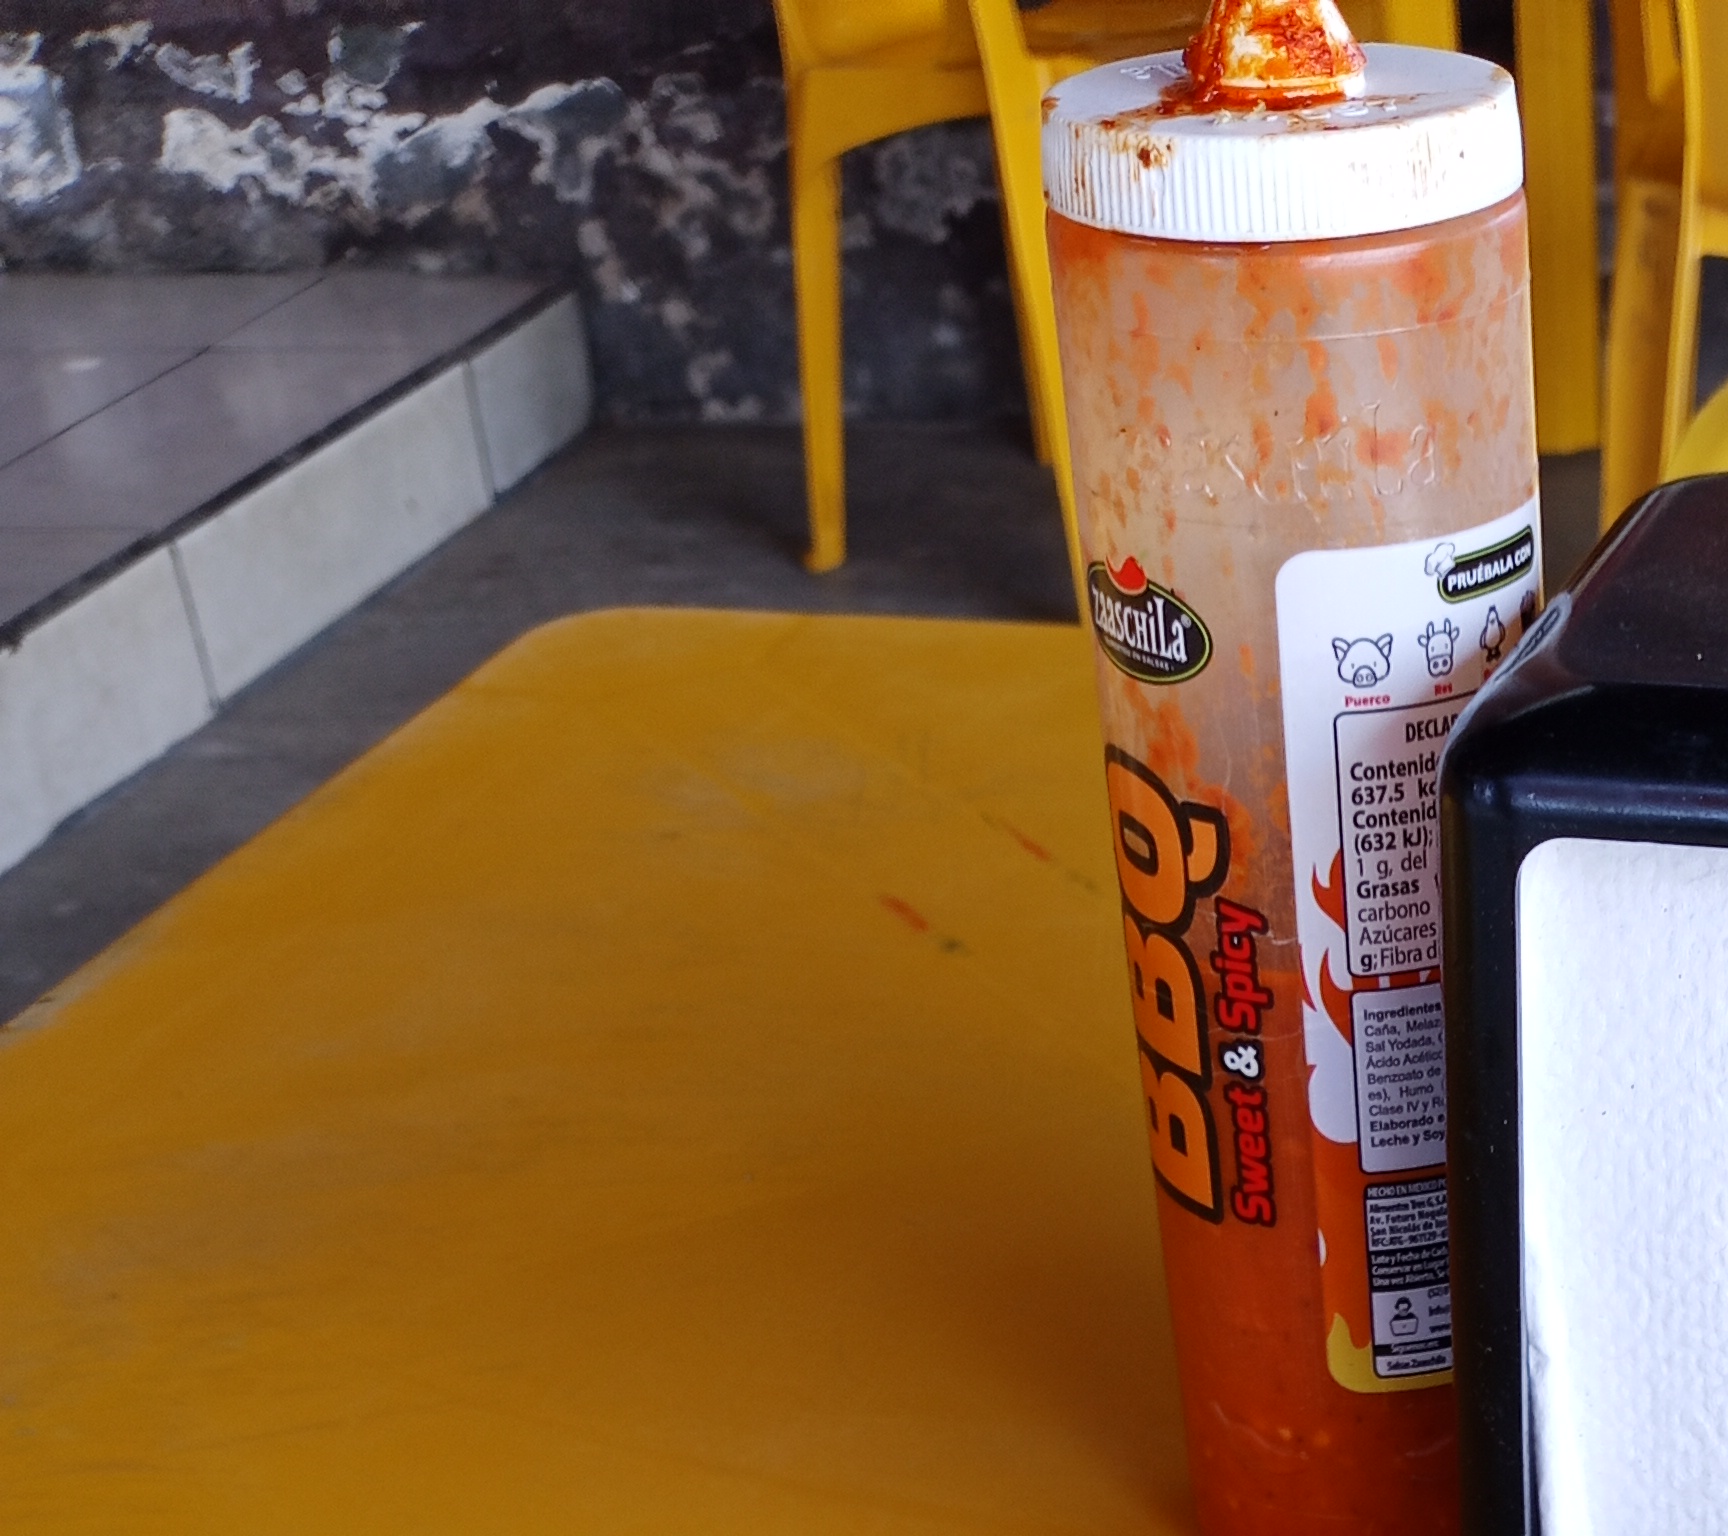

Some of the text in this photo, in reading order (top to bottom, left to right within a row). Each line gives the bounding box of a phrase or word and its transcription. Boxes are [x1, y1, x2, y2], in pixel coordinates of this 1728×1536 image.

[1447, 541, 1532, 592] PRUÉBALA CON
[1344, 694, 1391, 708] Puerco
[1350, 750, 1440, 781] Contenid
[1351, 783, 1405, 806] 637.5
[1352, 799, 1438, 829] Contenid
[1354, 832, 1397, 856] (632
[1400, 848, 1427, 872] del
[1356, 879, 1420, 899] Grasas
[1357, 900, 1431, 923] carbono
[1359, 922, 1437, 946] Azúcares
[1105, 747, 1230, 1220] BBQ
[1406, 1019, 1440, 1033] Melaz
[1366, 1040, 1386, 1053] Sal
[1215, 900, 1272, 1223] Sweet & Spicy
[1370, 1115, 1434, 1132] Elaborado
[1370, 1134, 1410, 1148] Leche
[1423, 1130, 1445, 1142] Soy
